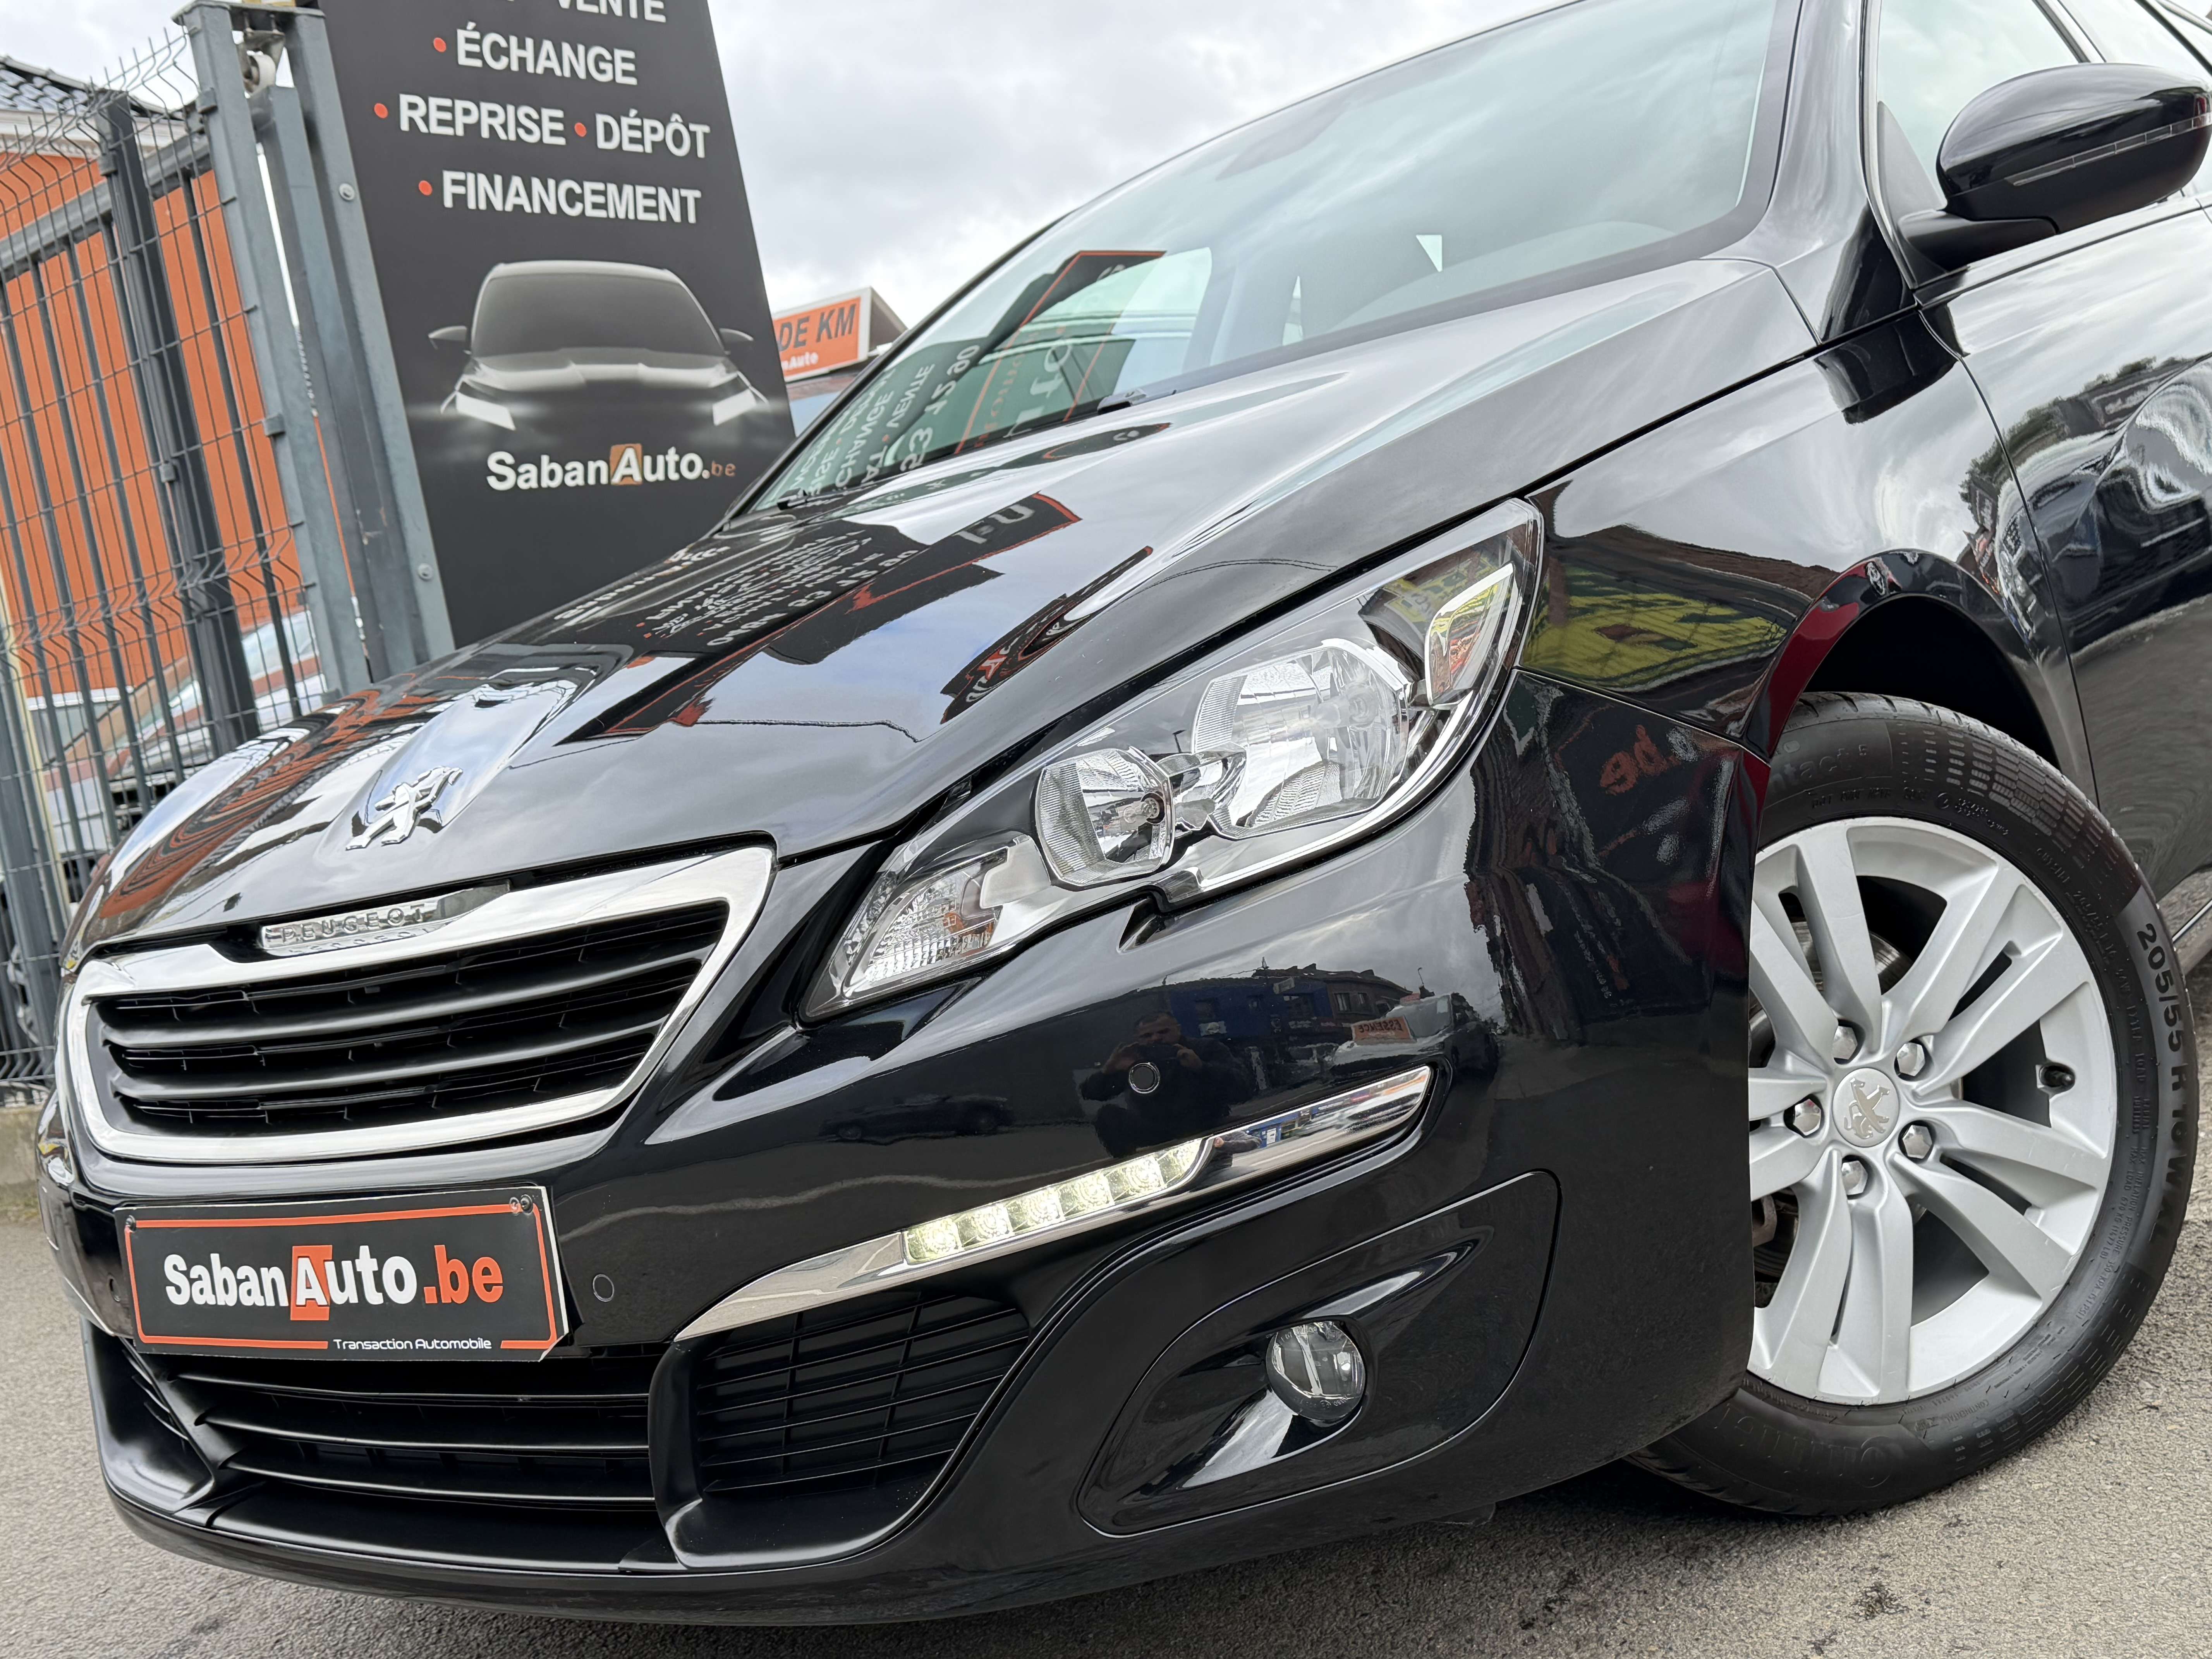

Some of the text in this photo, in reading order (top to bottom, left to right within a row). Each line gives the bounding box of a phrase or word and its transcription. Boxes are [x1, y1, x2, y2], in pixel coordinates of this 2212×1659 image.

[456, 22, 638, 85] ÉCHANGE
[398, 93, 711, 159] REPRISE DÉPÔT
[441, 170, 702, 224] FINANCEMENT
[778, 303, 856, 352] DE KM
[486, 446, 736, 491] SabanAuto.be
[281, 903, 425, 943] PEUGEOT
[2136, 923, 2184, 1052] 205/55
[2112, 1215, 2133, 1255] PRESSURE
[333, 1338, 492, 1351] Transaction Automobile
